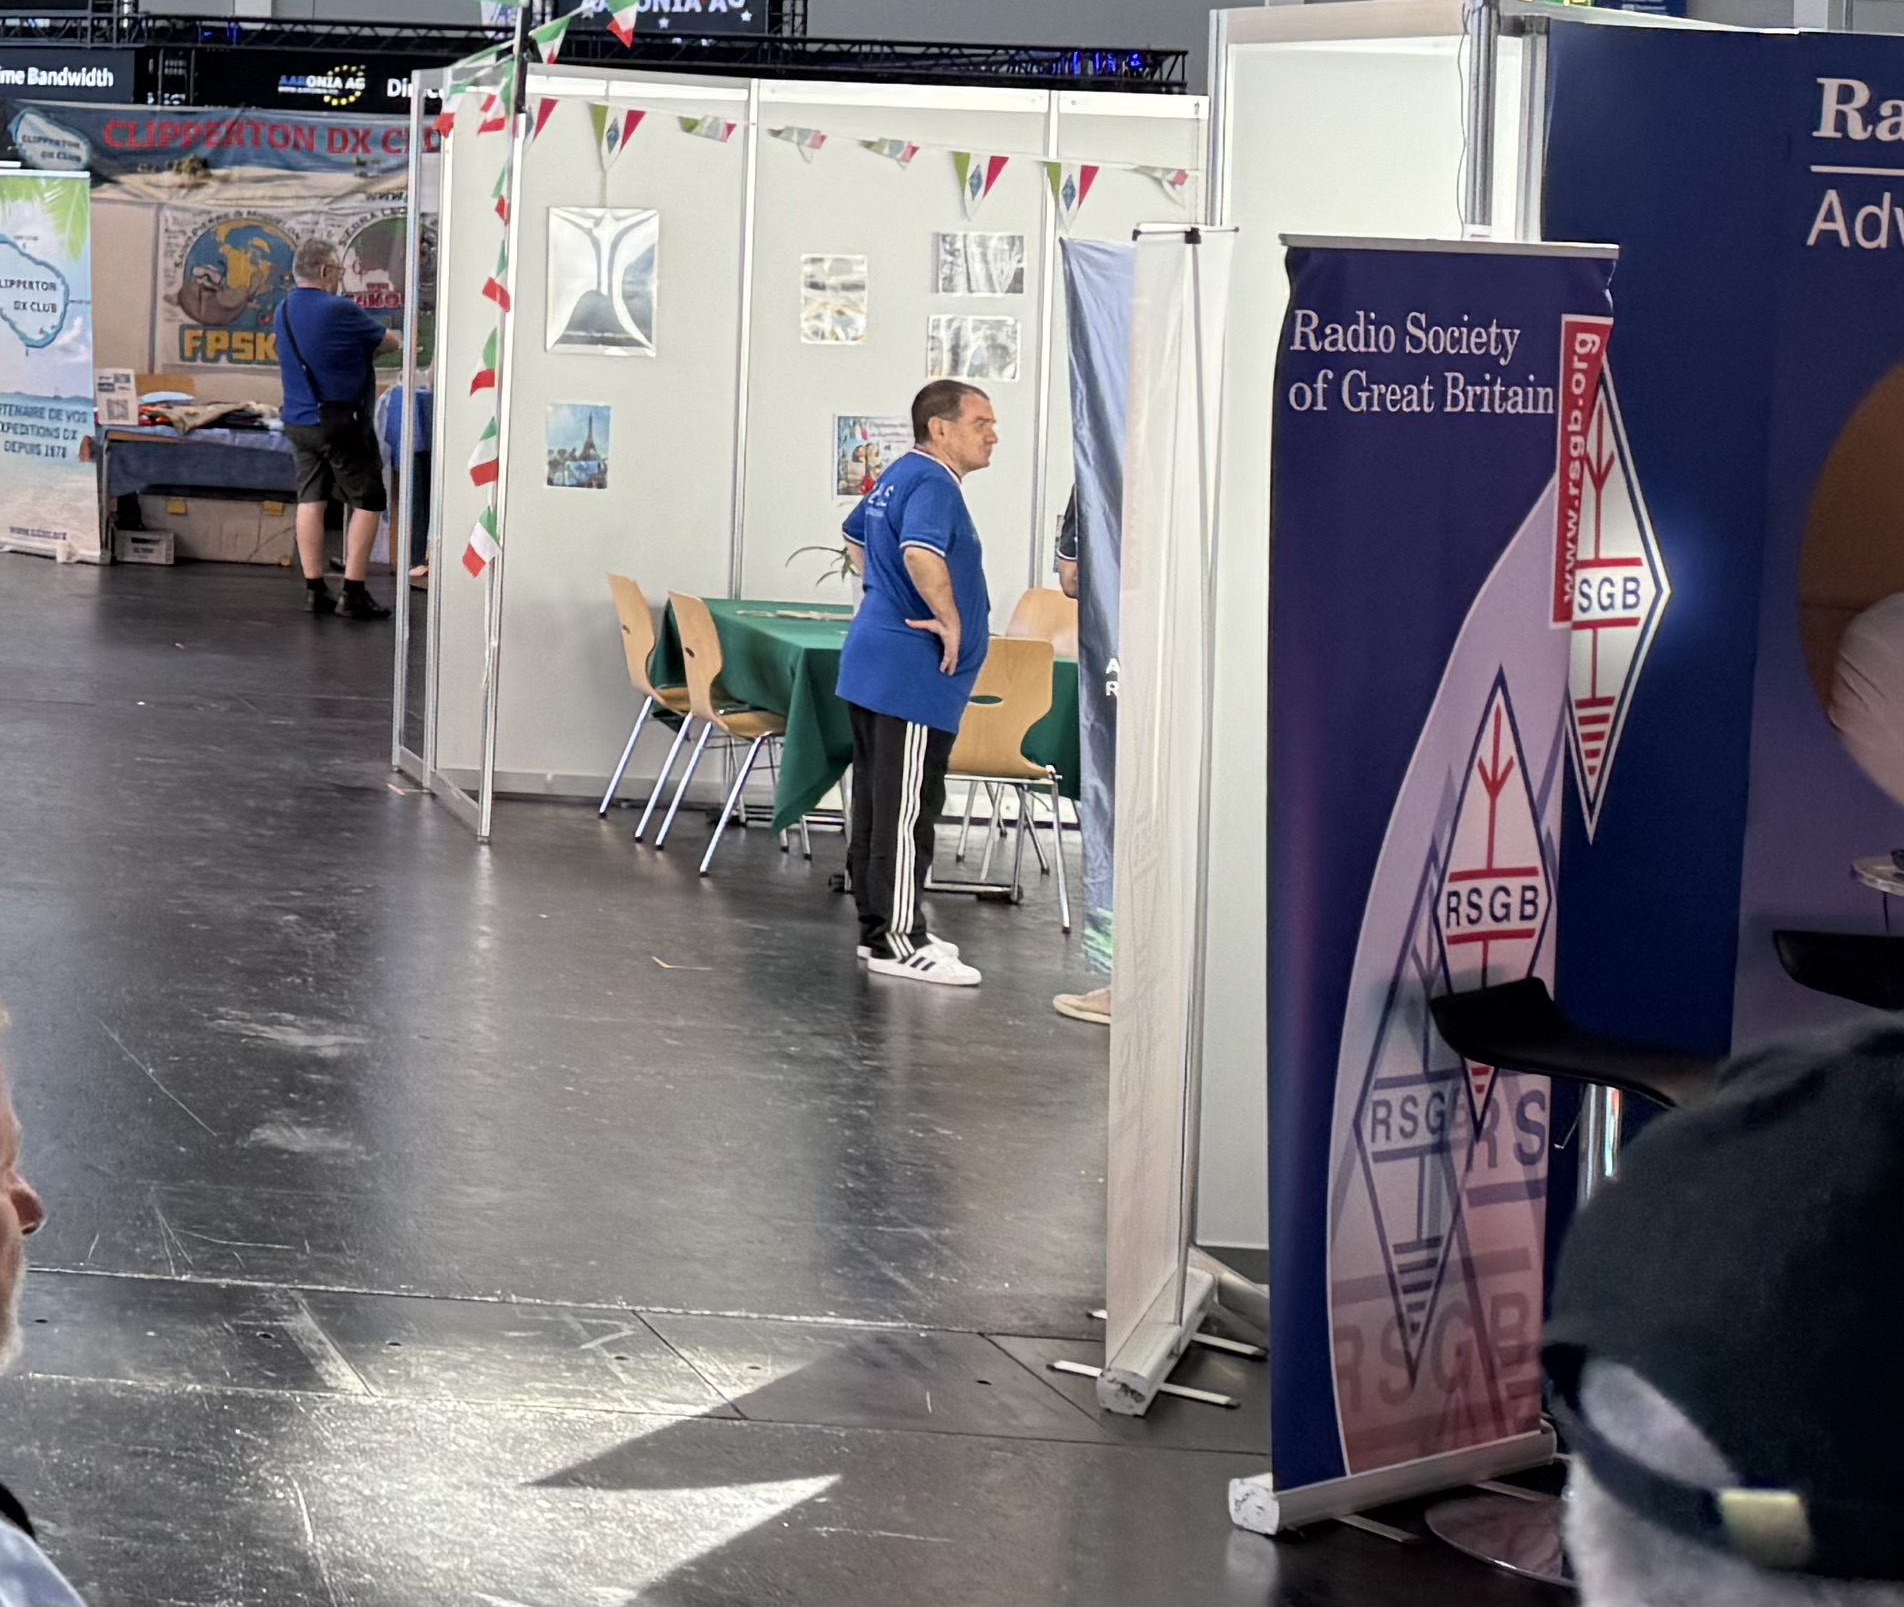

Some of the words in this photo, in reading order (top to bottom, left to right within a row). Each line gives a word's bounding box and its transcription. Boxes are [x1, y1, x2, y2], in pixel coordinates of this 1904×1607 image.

[28, 67, 114, 88] Bandwidth
[280, 75, 343, 89] AARONIA
[345, 77, 366, 90] AG
[1811, 77, 1904, 142] Ra
[103, 120, 315, 153] CLIPPERTON
[327, 126, 372, 154] DX
[29, 301, 57, 314] CLUB
[1289, 309, 1396, 355] Radio
[1405, 311, 1521, 366] Society
[1289, 368, 1329, 413] of
[1340, 371, 1437, 414] Great
[1442, 373, 1555, 415] Britain
[48, 406, 62, 420] DE
[64, 409, 88, 424] VOS
[4, 439, 43, 455] DEPUIS
[1563, 330, 1603, 603] www.rsgb.org
[1577, 574, 1641, 613] SGB
[1445, 885, 1540, 930] RSGB
